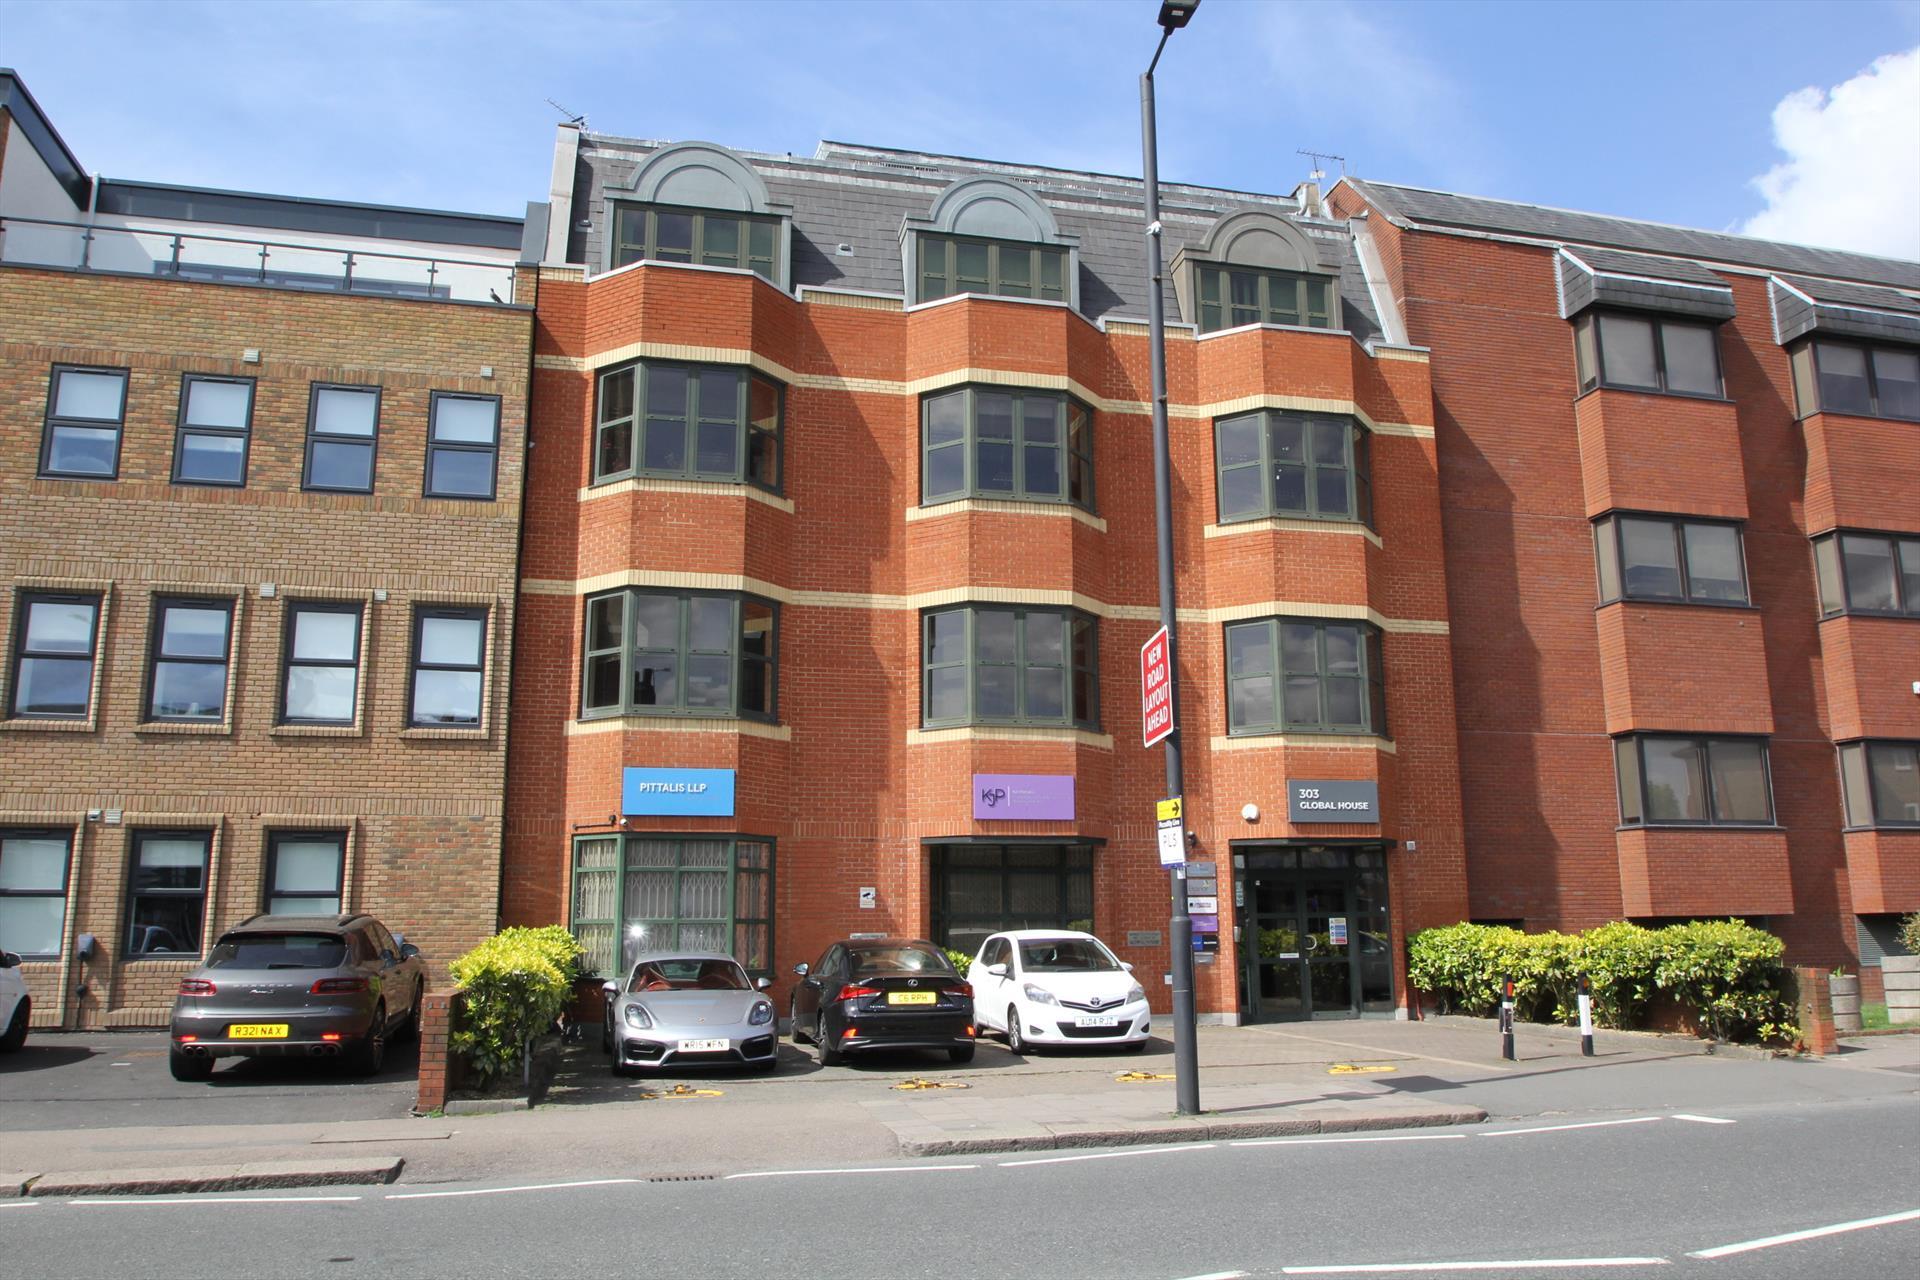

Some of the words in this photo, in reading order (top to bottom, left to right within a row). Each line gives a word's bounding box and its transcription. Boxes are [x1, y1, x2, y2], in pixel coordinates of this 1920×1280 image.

[1148, 642, 1162, 668] NEW
[1147, 663, 1164, 690] ROAD
[1145, 681, 1168, 713] LAYOUT
[1147, 705, 1168, 733] AHEAD
[640, 782, 685, 792] PITTALIS
[687, 783, 707, 793] LLP
[1299, 788, 1320, 799] 303
[1299, 801, 1337, 810] GLOBAL
[1338, 801, 1369, 810] HOUSE
[235, 1026, 258, 1036] R321
[260, 1026, 282, 1035] NAX
[706, 1039, 724, 1048] WFN
